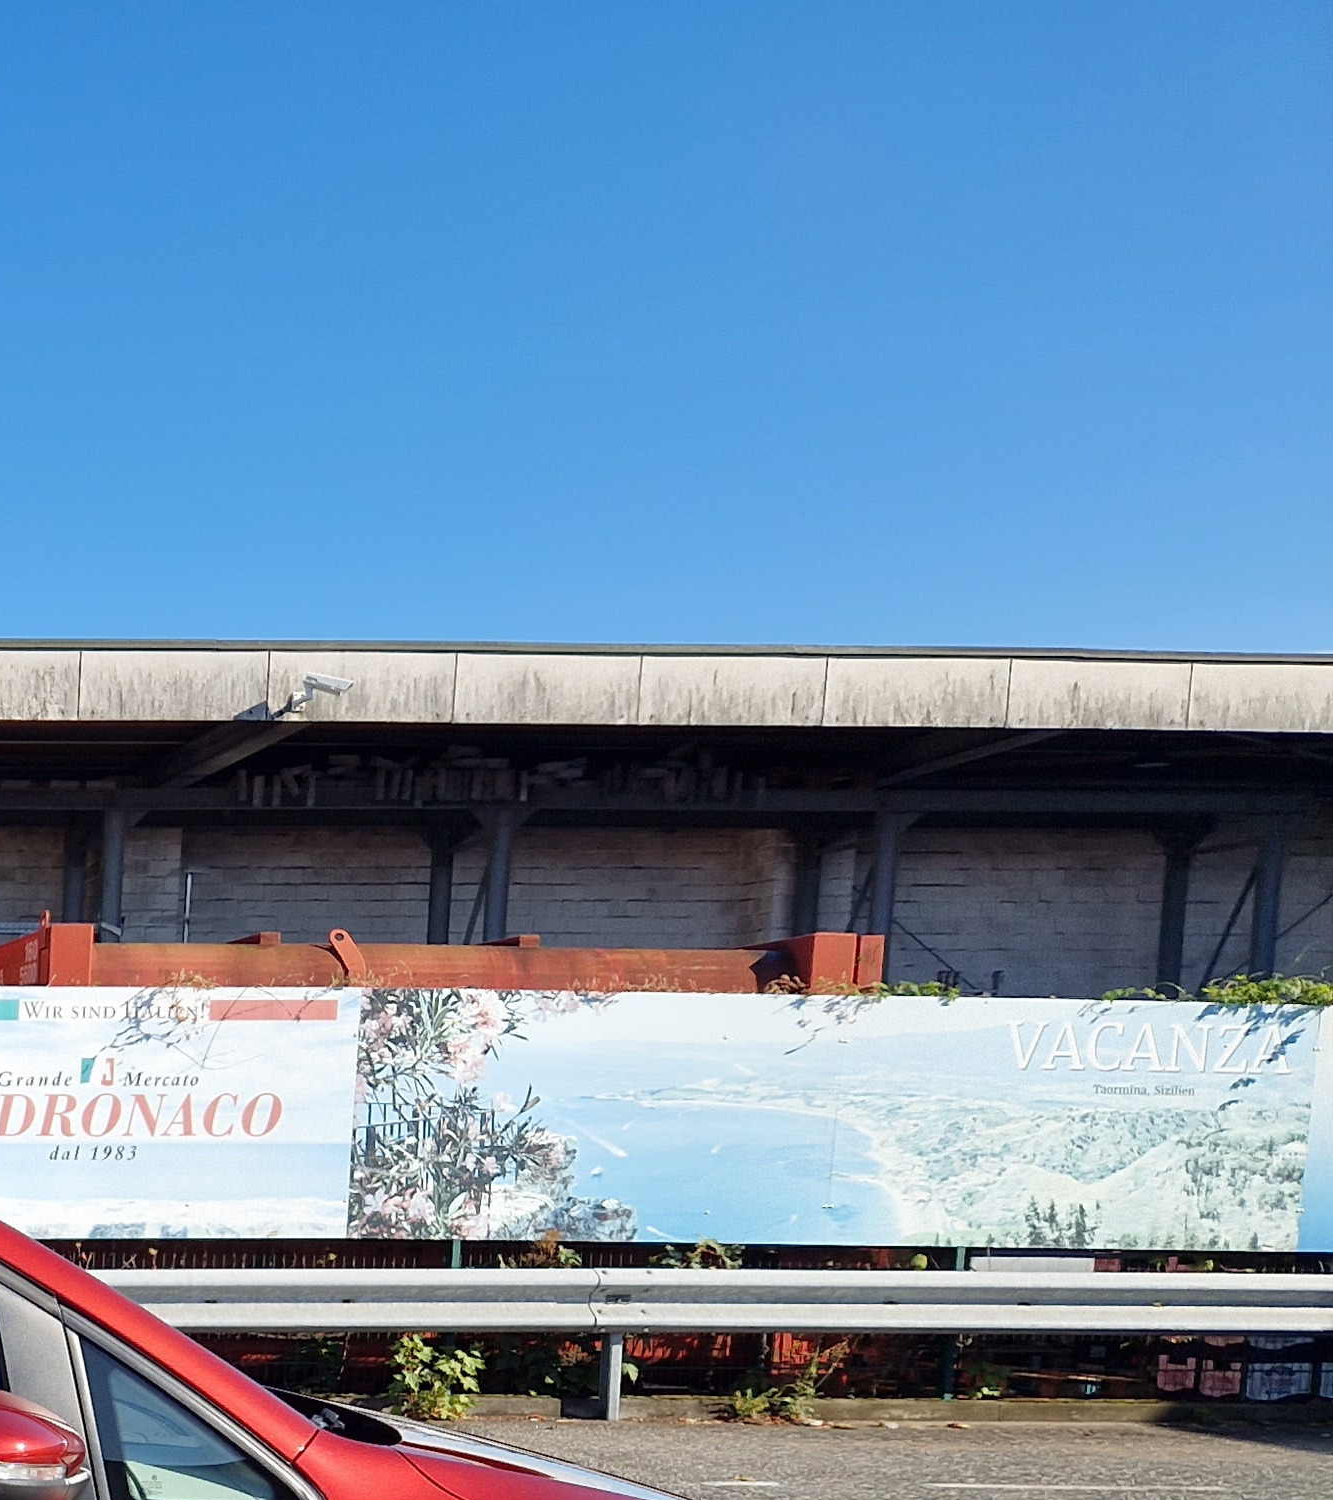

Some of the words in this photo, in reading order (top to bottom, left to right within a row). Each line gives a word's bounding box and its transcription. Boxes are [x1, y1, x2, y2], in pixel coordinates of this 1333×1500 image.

[22, 1001, 63, 1019] WIR
[71, 1005, 116, 1019] SIND
[1008, 1020, 1293, 1075] VACANZA
[122, 1072, 199, 1087] Mercato
[1092, 1084, 1151, 1096] Taormina,
[1154, 1084, 1196, 1096] Sizilien
[48, 1145, 80, 1161] dal
[89, 1145, 139, 1162] 1983
